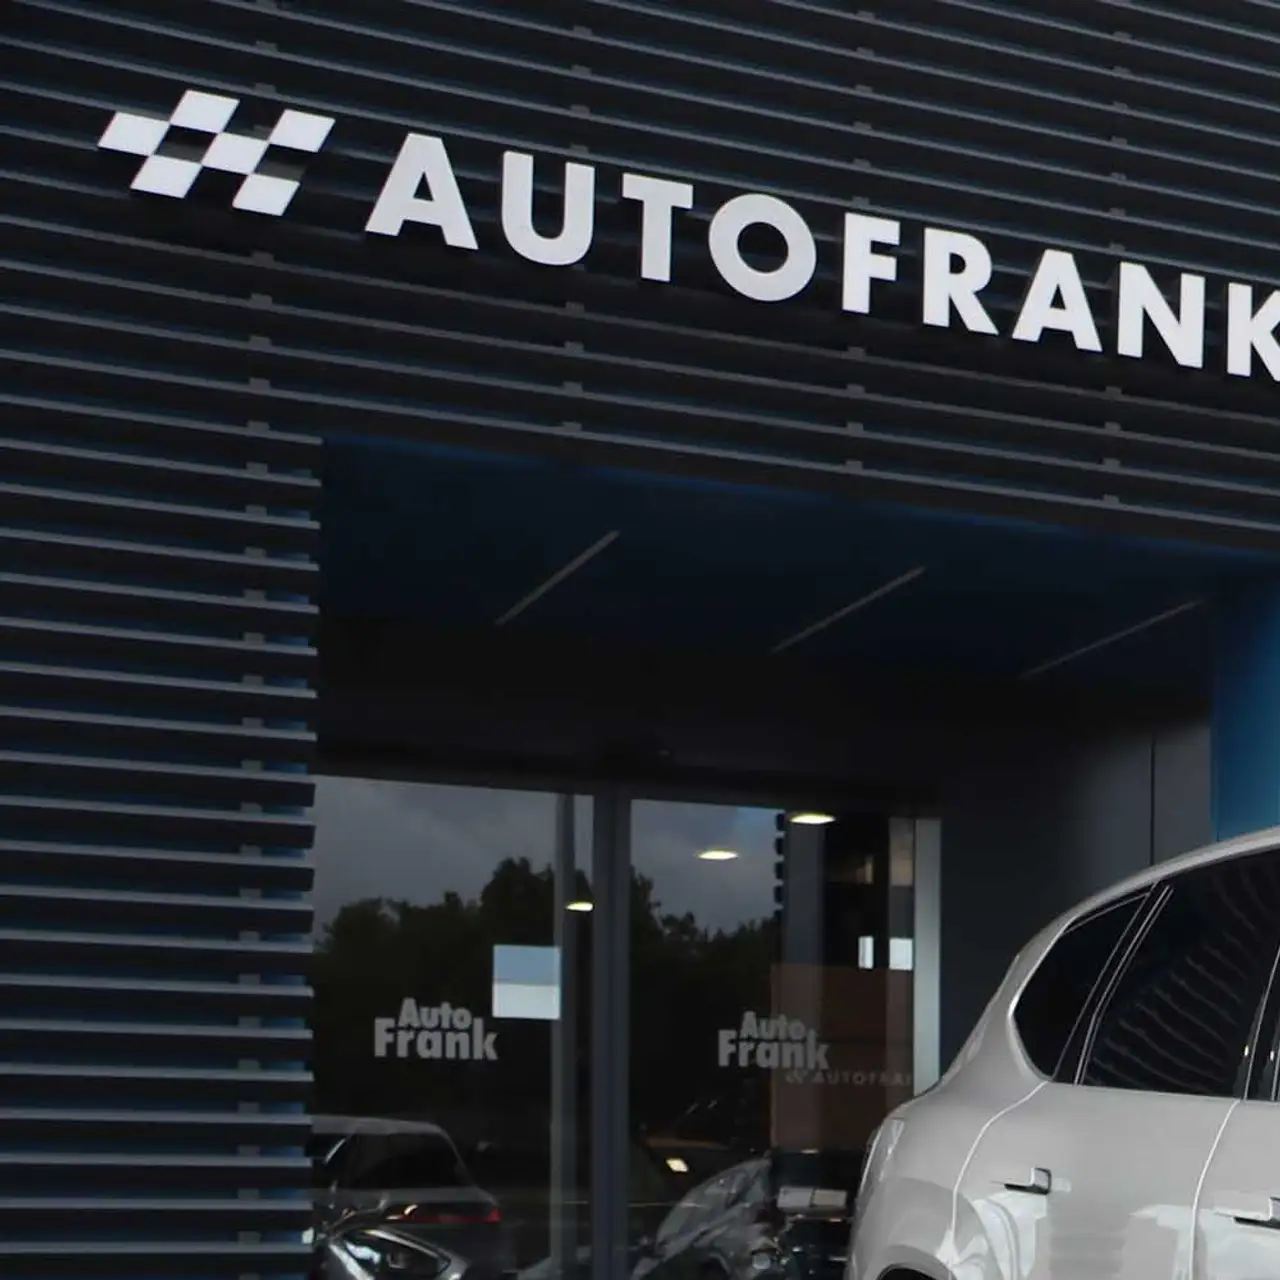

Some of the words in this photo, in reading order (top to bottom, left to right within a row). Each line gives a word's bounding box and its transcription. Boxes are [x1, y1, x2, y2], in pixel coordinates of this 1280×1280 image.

[398, 997, 472, 1030] Auto
[740, 1010, 806, 1041] Auto
[374, 1017, 499, 1060] Frank
[718, 1027, 830, 1070] Frank
